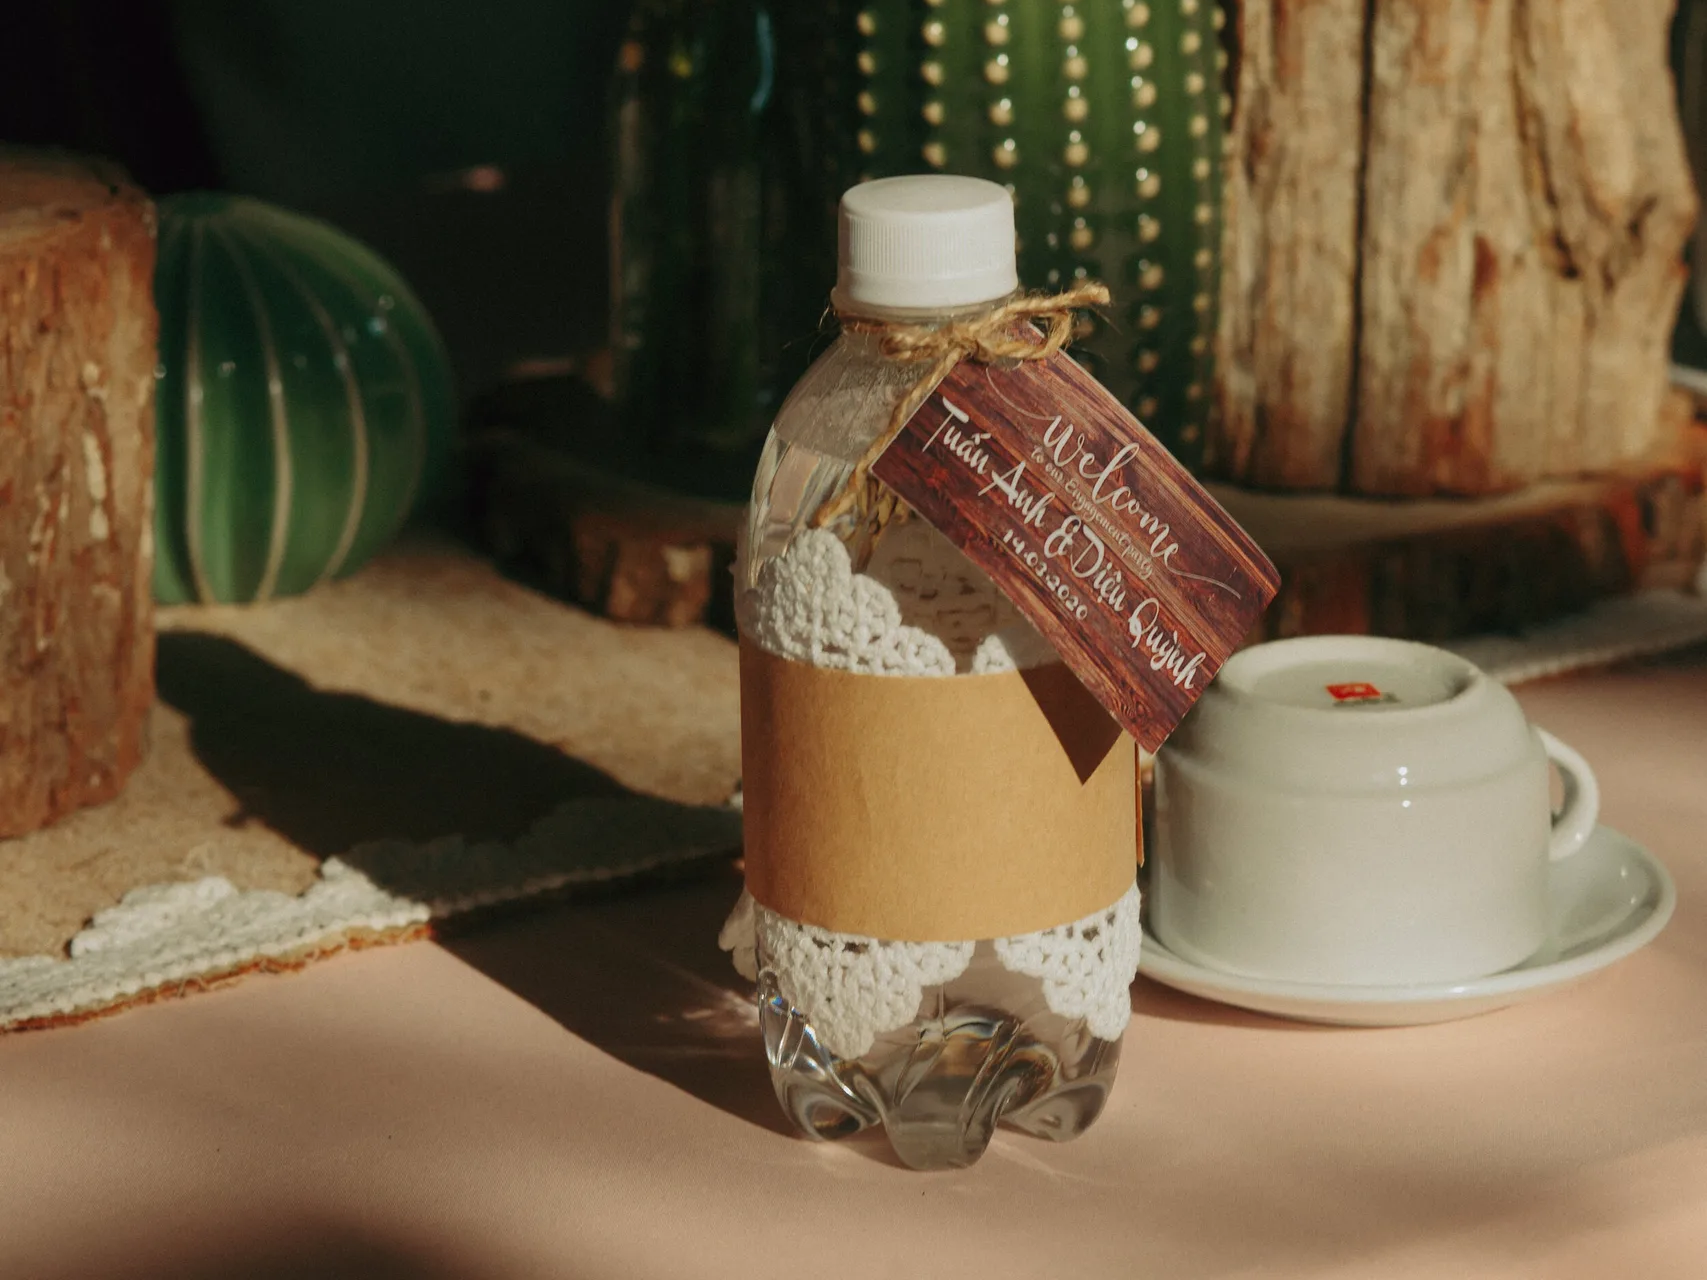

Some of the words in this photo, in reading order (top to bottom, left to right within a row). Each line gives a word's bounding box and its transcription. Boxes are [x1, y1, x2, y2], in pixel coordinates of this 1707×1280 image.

[922, 396, 991, 475] Tuấn
[978, 460, 1055, 528] Anh
[1128, 598, 1206, 689] Quỳnh
[1003, 529, 1088, 619] 14.03.2020
[1030, 445, 1044, 464] to
[1065, 478, 1132, 546] Engagement
[1121, 543, 1153, 580] party
